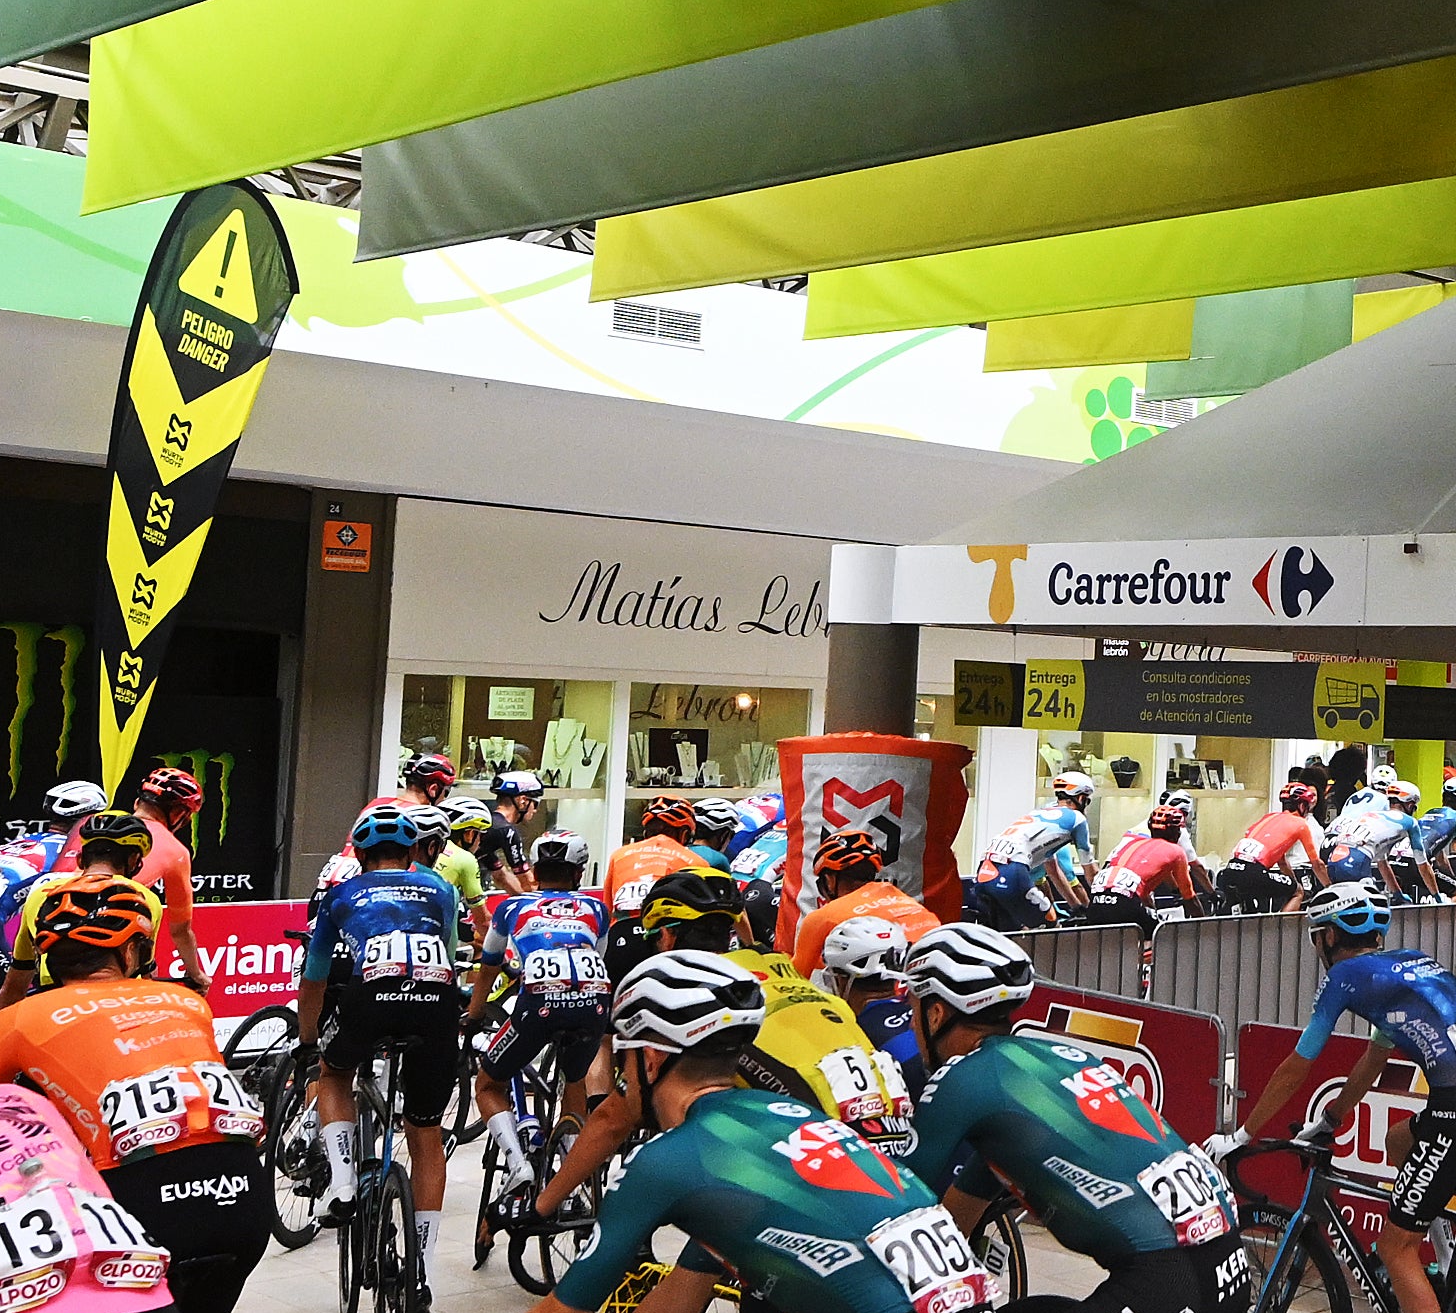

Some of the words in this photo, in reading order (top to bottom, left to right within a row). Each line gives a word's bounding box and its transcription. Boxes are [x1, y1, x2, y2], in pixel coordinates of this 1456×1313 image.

[181, 309, 234, 350] PELIGRO
[177, 333, 231, 373] DANGER
[538, 559, 727, 634] Matías
[1048, 558, 1232, 606] Carrefour
[1029, 670, 1076, 687] Entrega
[1142, 670, 1187, 684] Consulta
[1189, 671, 1251, 685] condiciones
[1146, 692, 1160, 702] en
[1162, 690, 1178, 702] los
[1179, 692, 1245, 705] mostradores
[1026, 688, 1076, 719] 24h
[1140, 708, 1153, 720] de
[1154, 708, 1197, 722] Atención
[1203, 711, 1213, 722] al
[1215, 711, 1252, 724] Cliente
[367, 940, 392, 964] 51
[417, 940, 444, 965] 51
[532, 956, 561, 979] 35
[581, 956, 606, 979] 35
[224, 983, 237, 995] el
[238, 981, 267, 994] cielo
[270, 982, 285, 992] es
[375, 992, 440, 1003] DECATHLON
[544, 1000, 598, 1008] OUTDOOR
[842, 1055, 868, 1092] 5
[27, 1067, 100, 1141] ORBEA
[102, 1076, 179, 1129] 215
[1050, 1157, 1124, 1205] FINISHER
[1392, 1161, 1417, 1205] AG2R
[1413, 1140, 1430, 1162] LA
[1401, 1134, 1454, 1216] MONDIALE
[761, 1227, 852, 1273] FINISHER
[886, 1219, 970, 1289] 205
[1327, 1222, 1351, 1262] VAN
